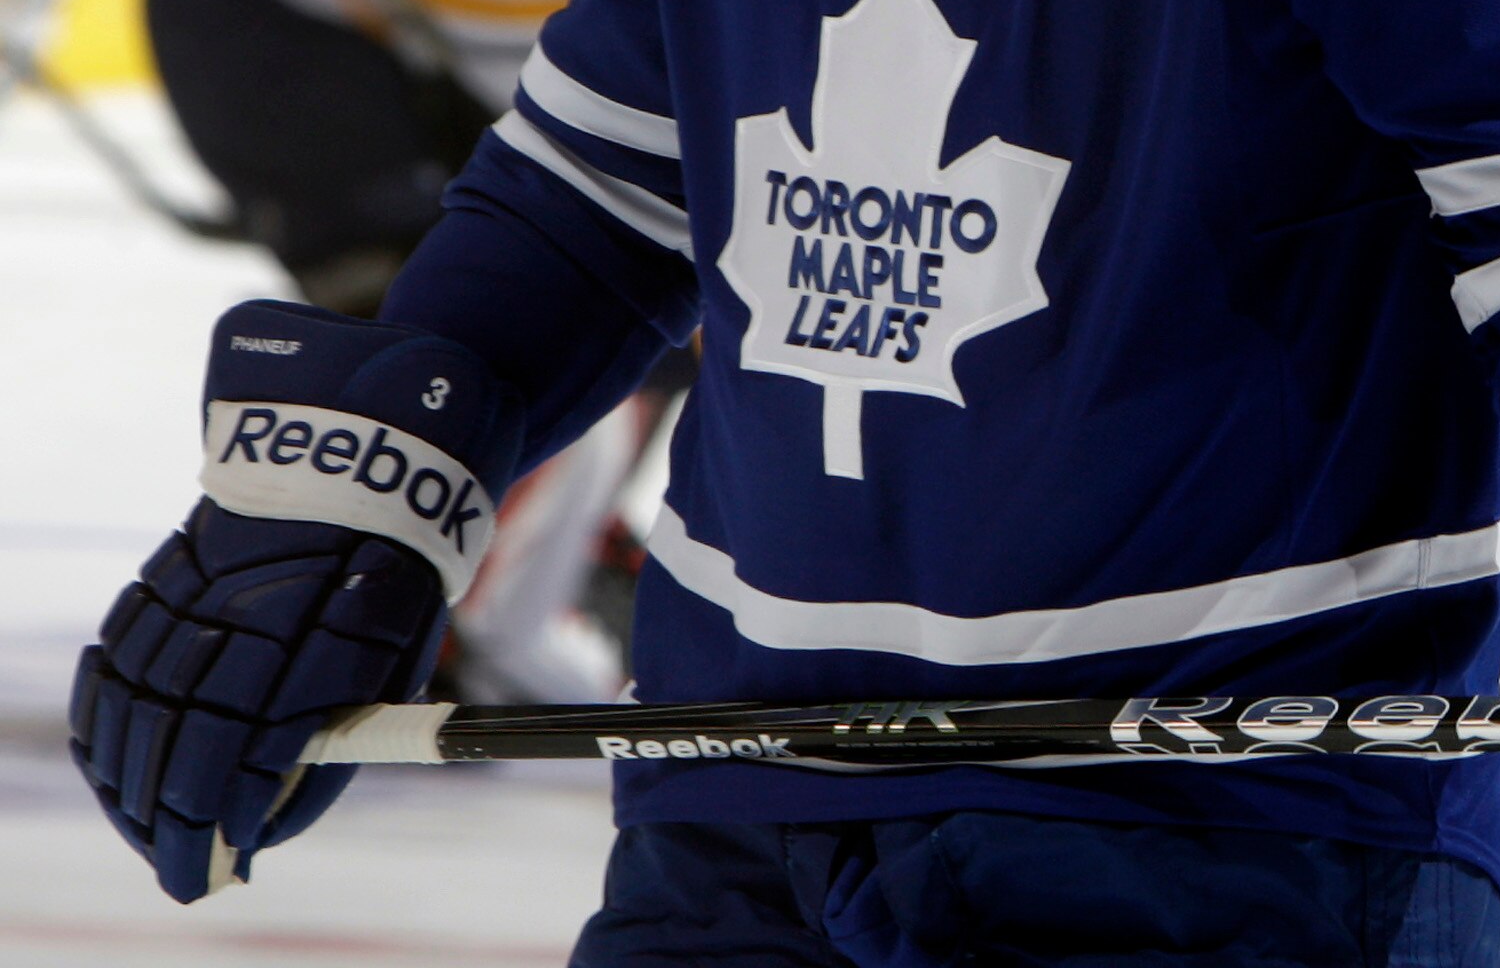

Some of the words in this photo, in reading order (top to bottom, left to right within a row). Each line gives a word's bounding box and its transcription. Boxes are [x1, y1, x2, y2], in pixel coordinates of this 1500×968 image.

[765, 169, 997, 254] TORONTO
[788, 235, 945, 308] MAPLE
[785, 297, 929, 363] LEAFS
[420, 376, 452, 411] 3
[218, 407, 481, 555] Reebok
[595, 734, 797, 760] Reebok
